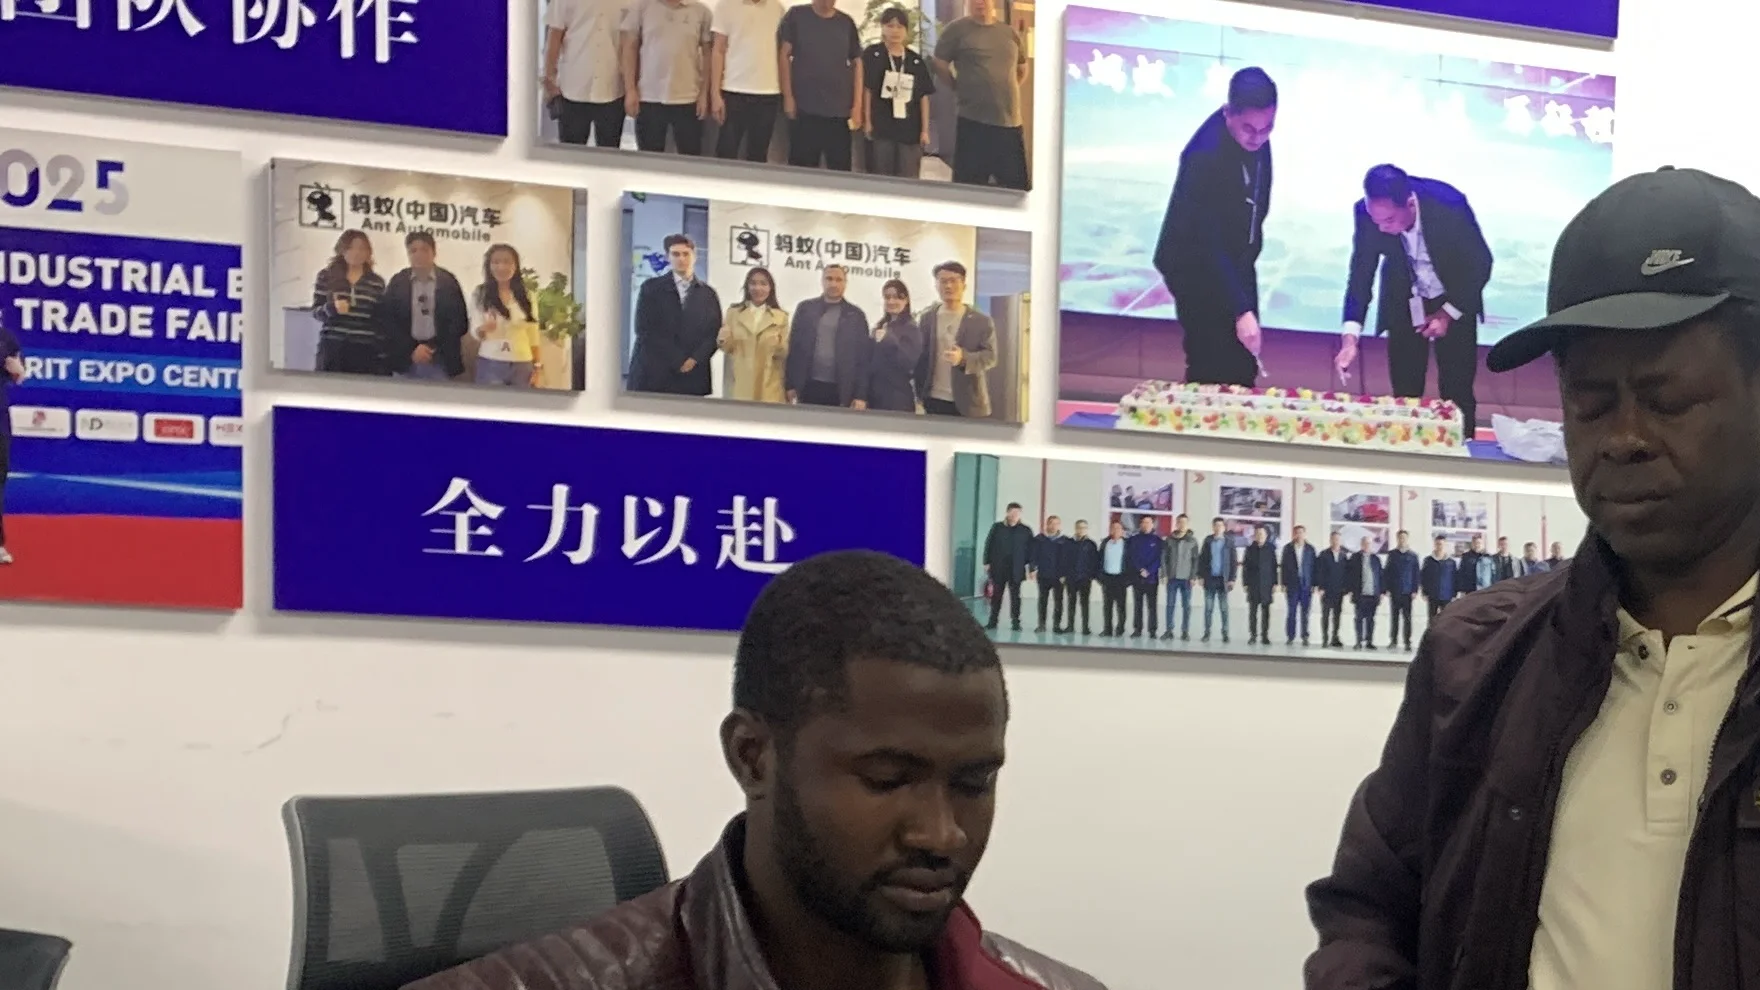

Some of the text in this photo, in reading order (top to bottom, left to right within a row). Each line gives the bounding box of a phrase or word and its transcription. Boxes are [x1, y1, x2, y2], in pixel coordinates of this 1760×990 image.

[361, 217, 391, 232] Ant
[784, 256, 902, 280] Ant Aomobile
[13, 297, 154, 338] TRADE
[79, 359, 156, 386] EXPO
[163, 364, 242, 390] CENT
[422, 476, 798, 575] 全力以赴
